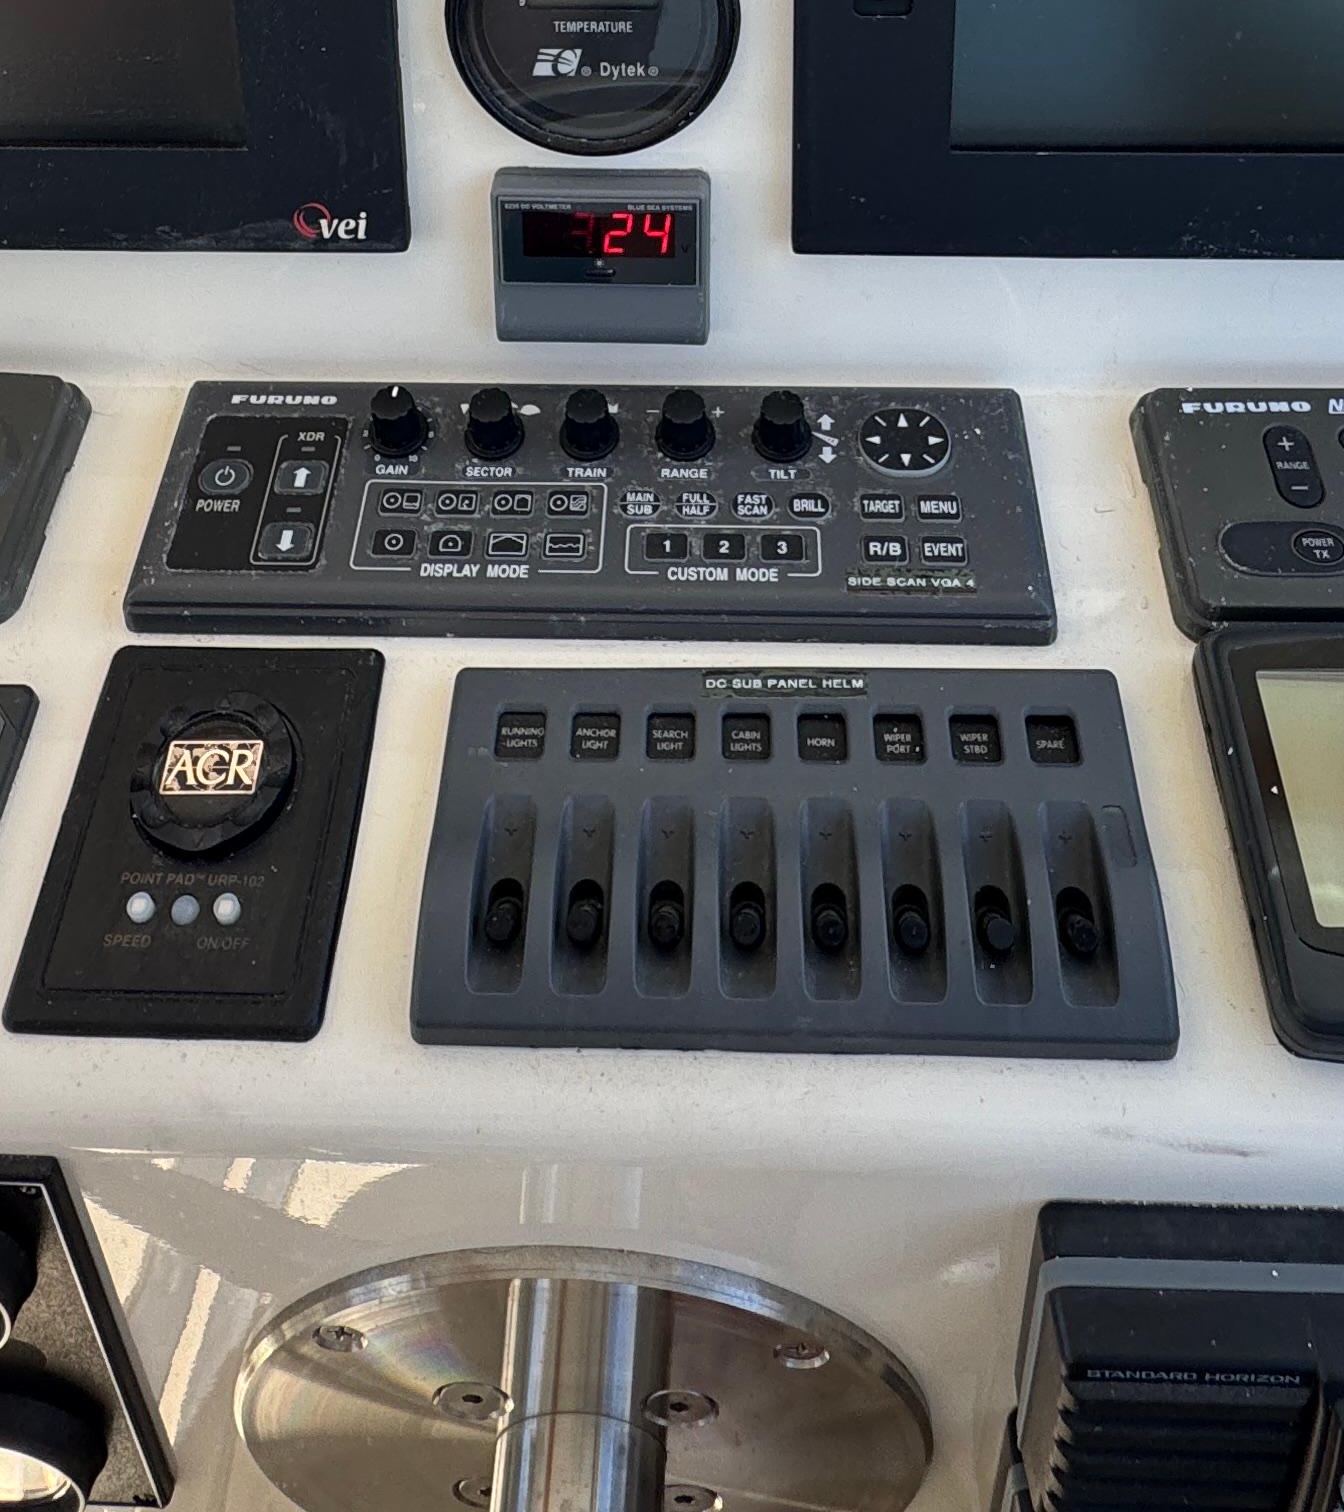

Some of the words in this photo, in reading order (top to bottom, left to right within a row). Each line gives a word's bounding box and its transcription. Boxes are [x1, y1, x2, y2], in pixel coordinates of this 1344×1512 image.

[554, 20, 632, 33] TEMPERATURE
[320, 212, 367, 239] vei
[231, 394, 337, 405] FURUNO
[1182, 402, 1311, 413] FURUNO
[297, 432, 324, 441] XDR
[376, 465, 408, 476] GAIN
[1276, 461, 1310, 470] RANGE
[465, 466, 512, 478] SECTOR
[566, 467, 607, 479] TRAIN
[661, 468, 707, 479] RANGE
[769, 469, 797, 479] TILT
[626, 492, 654, 502] MAIN
[682, 493, 710, 503] FULL
[737, 494, 767, 504] FAST
[195, 499, 240, 512] POWER
[627, 504, 652, 514] SUB
[682, 505, 710, 515] HALF
[737, 505, 767, 516] SCAN
[793, 499, 825, 513] BRILL
[863, 500, 900, 514] TARGET
[921, 500, 957, 514] MENU
[663, 541, 671, 553] 1
[719, 541, 729, 554] 2
[777, 541, 787, 554] 3
[1301, 538, 1334, 547] POWER
[869, 542, 901, 556] R/B
[924, 543, 963, 557] EVENT
[1313, 550, 1330, 559] TX
[420, 564, 479, 578] DISPLAY
[486, 565, 529, 578] MODE
[668, 568, 728, 581] CUSTOM
[736, 569, 778, 581] MODE
[848, 577, 882, 586] SIDE
[887, 578, 926, 587] SCAN
[931, 578, 963, 587] VGA
[706, 679, 726, 688] DC
[732, 680, 762, 689] SUB
[767, 679, 816, 689] PANEL
[822, 679, 864, 689] HELM
[501, 727, 544, 736] RUNNING
[575, 728, 617, 737] ANCHOR
[652, 730, 688, 738] SEARCH
[731, 731, 760, 739] CABIN
[807, 738, 835, 747] HORN
[884, 734, 911, 742] WIPER
[960, 733, 988, 742] WIPER
[505, 739, 538, 748] LIGHTS
[582, 740, 608, 749] LIGHT
[657, 741, 683, 750] LIGHT
[730, 742, 762, 752] LIGHTS
[887, 744, 911, 753] PORT
[1036, 739, 1064, 749] SPARE
[964, 745, 988, 754] STBD
[165, 749, 254, 785] ACR
[121, 872, 163, 884] POINT
[207, 874, 265, 887] URP-102
[104, 935, 152, 948] SPEED
[197, 937, 250, 949] ON/OFF
[1087, 1369, 1198, 1381] STANDARD
[1205, 1371, 1300, 1384] HORIZON
